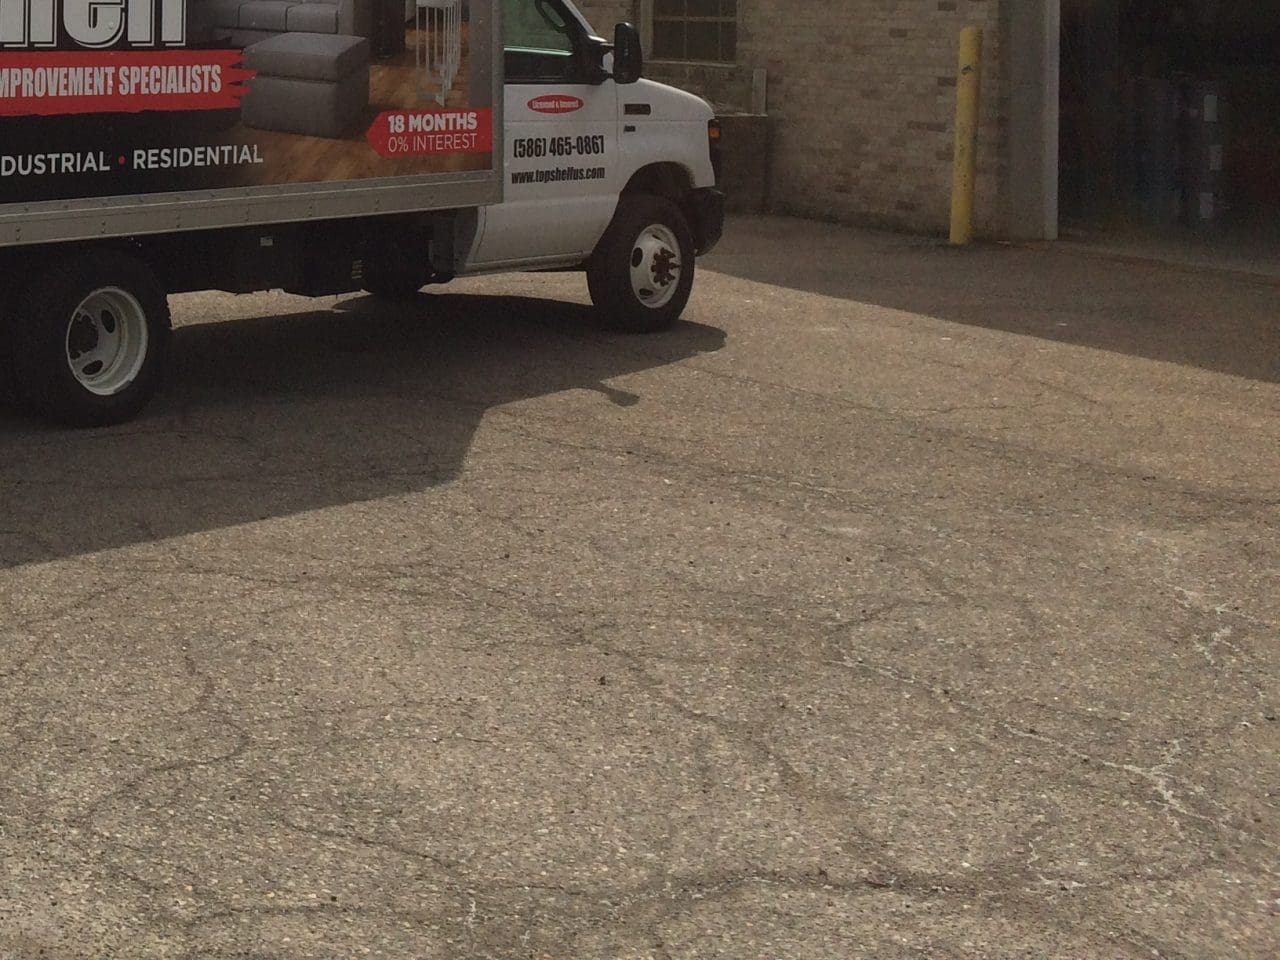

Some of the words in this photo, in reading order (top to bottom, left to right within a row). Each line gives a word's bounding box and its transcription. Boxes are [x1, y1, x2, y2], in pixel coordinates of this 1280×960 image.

[119, 63, 222, 96] SPECIALISTS
[388, 114, 405, 134] 18
[408, 111, 478, 133] MONTHS
[388, 135, 409, 153] 0%
[413, 133, 478, 152] INTEREST
[513, 138, 547, 159] (586)
[549, 135, 606, 158] 465-0867
[132, 143, 264, 170] RESIDENTIAL
[511, 165, 606, 185] www.topshelfus.com
